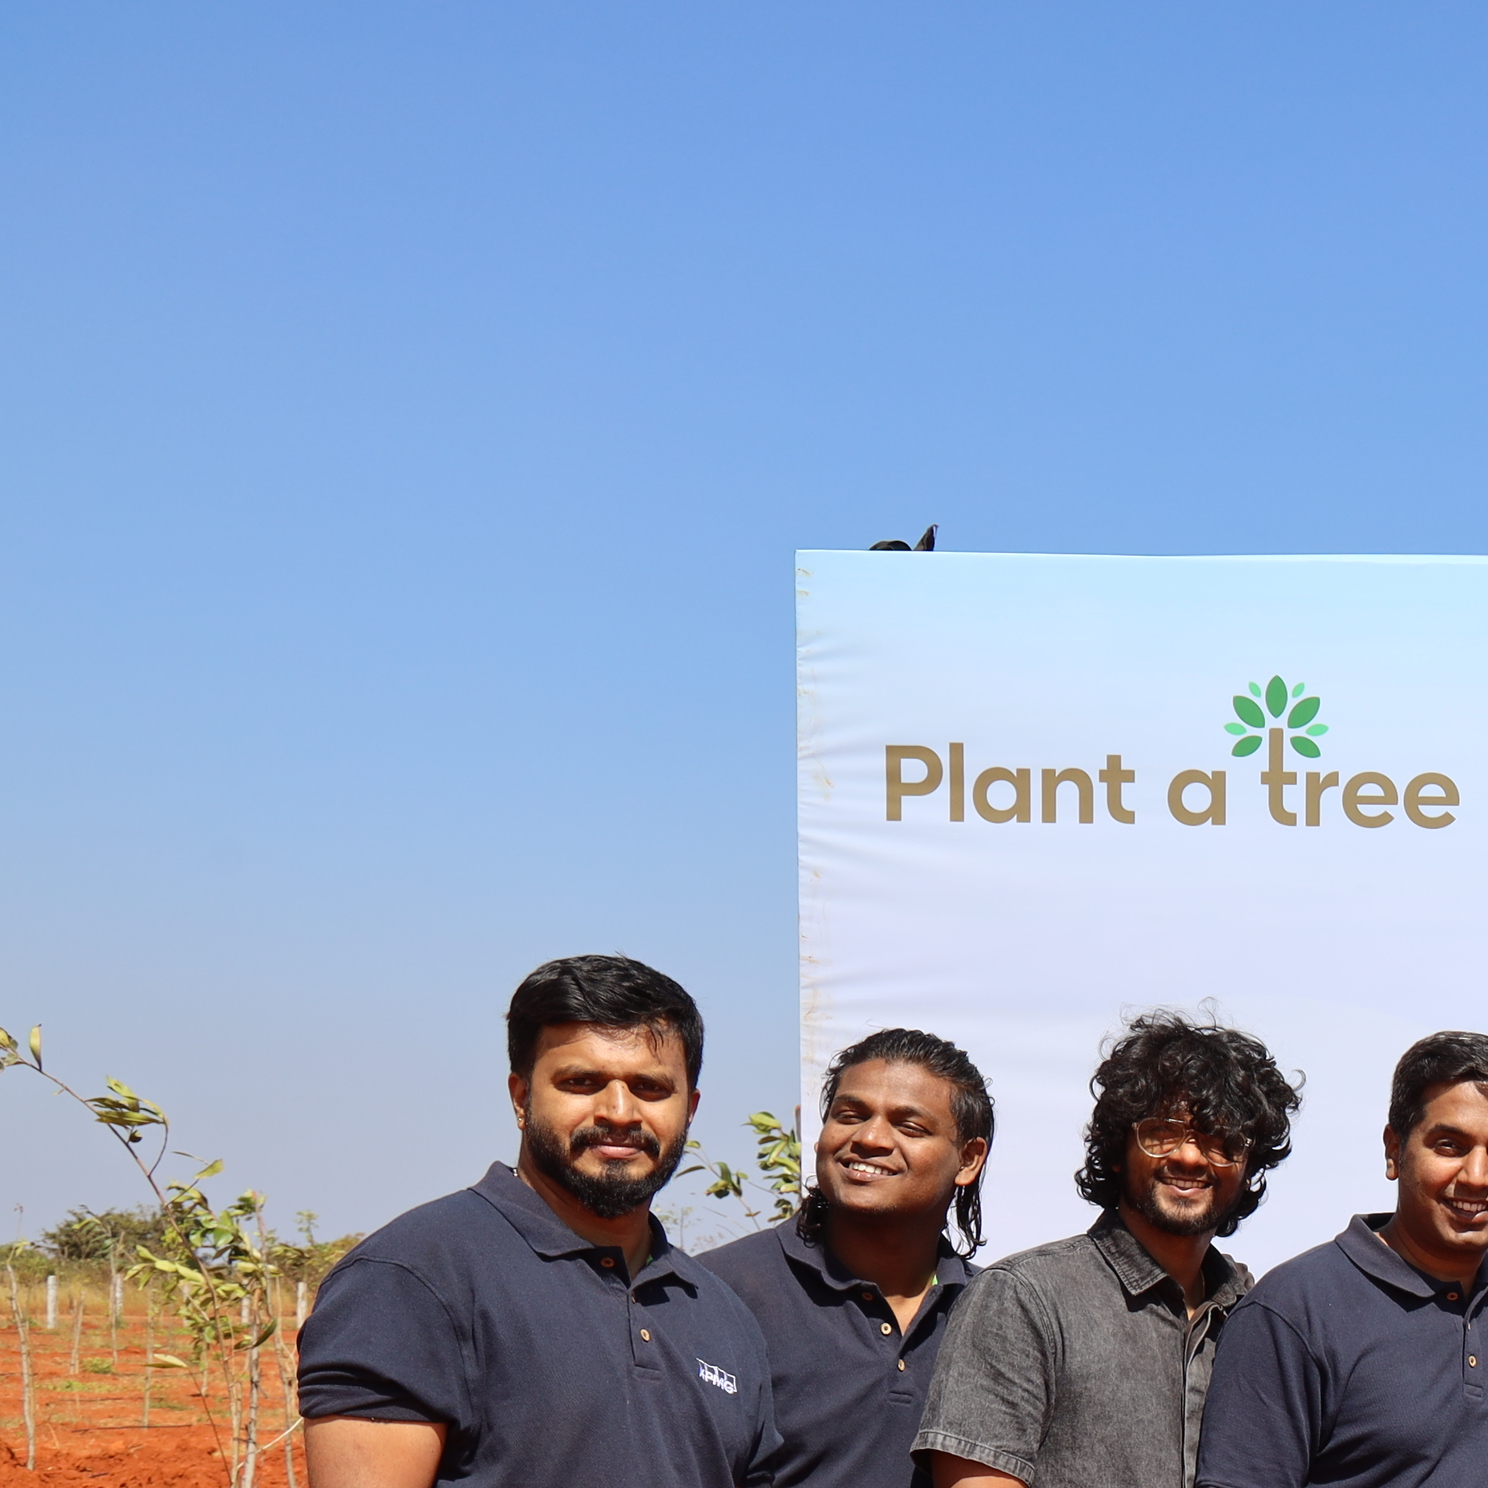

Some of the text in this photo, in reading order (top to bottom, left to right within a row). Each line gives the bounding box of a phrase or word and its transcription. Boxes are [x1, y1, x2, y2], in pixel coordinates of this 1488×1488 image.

[884, 727, 1461, 830] Plant a tree
